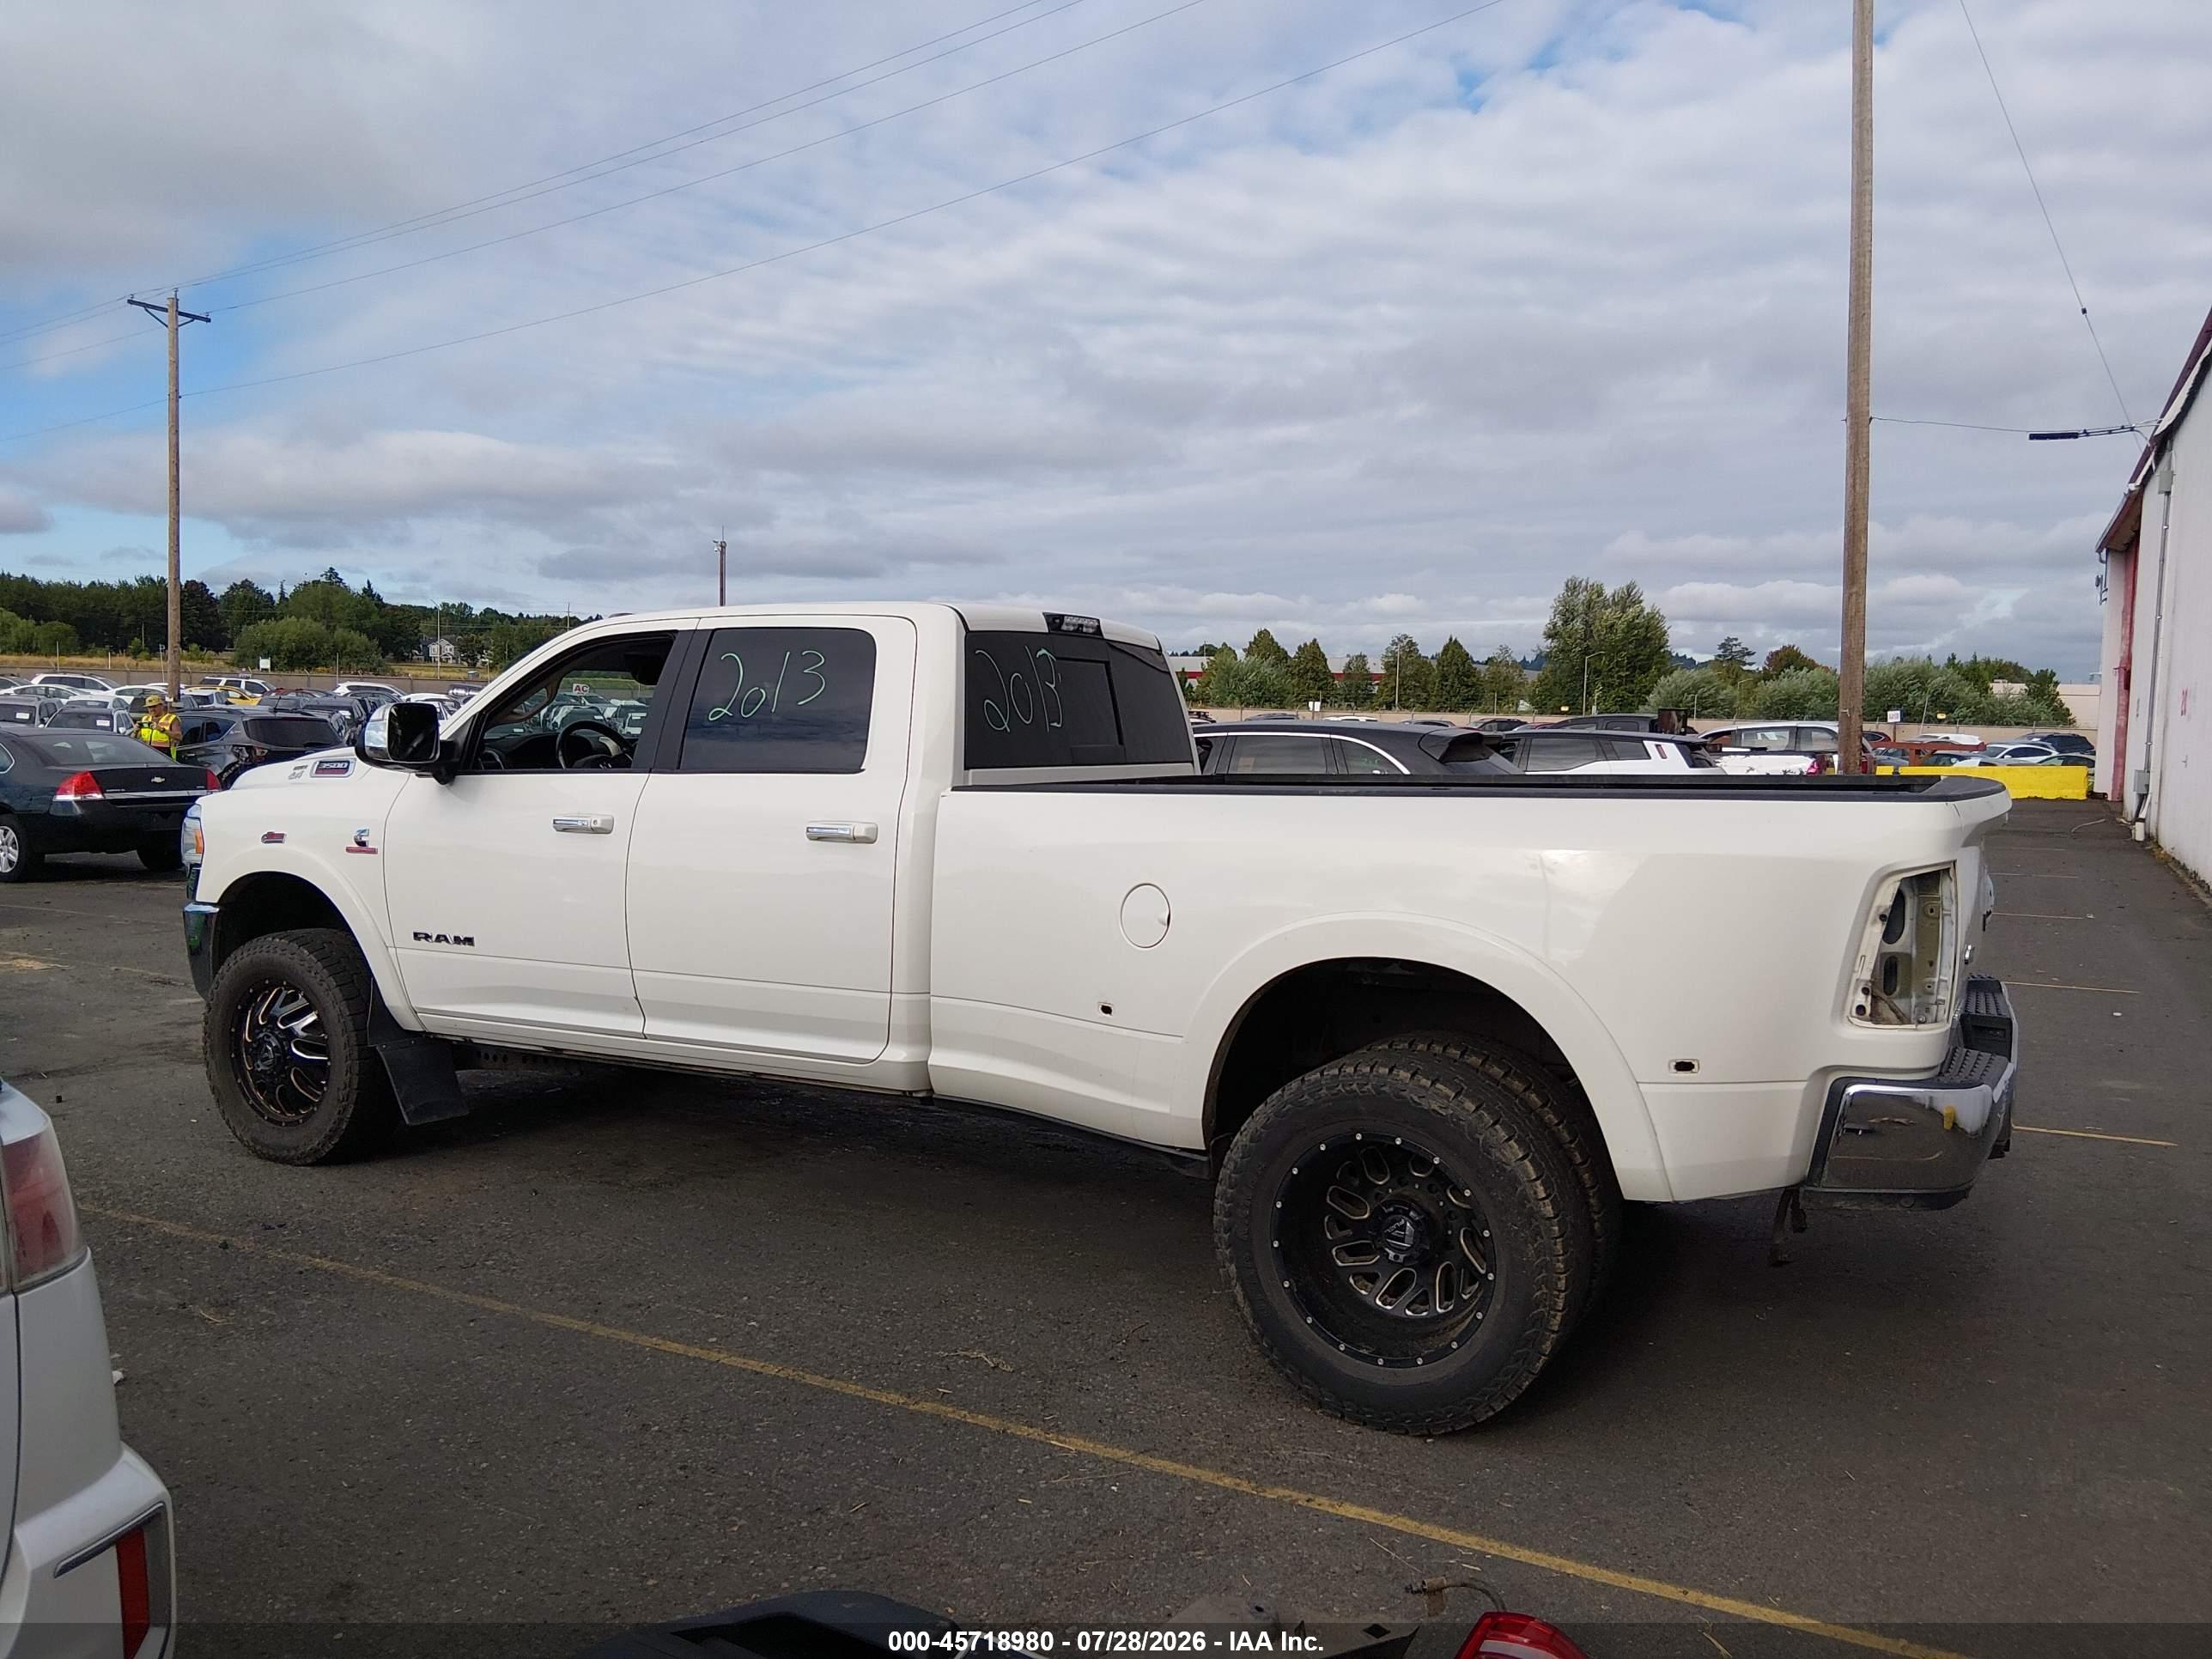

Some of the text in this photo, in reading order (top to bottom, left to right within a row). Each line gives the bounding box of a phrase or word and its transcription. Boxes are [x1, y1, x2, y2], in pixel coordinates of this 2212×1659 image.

[708, 649, 826, 722] 2013
[975, 645, 1063, 732] 2013
[412, 932, 476, 947] RAM
